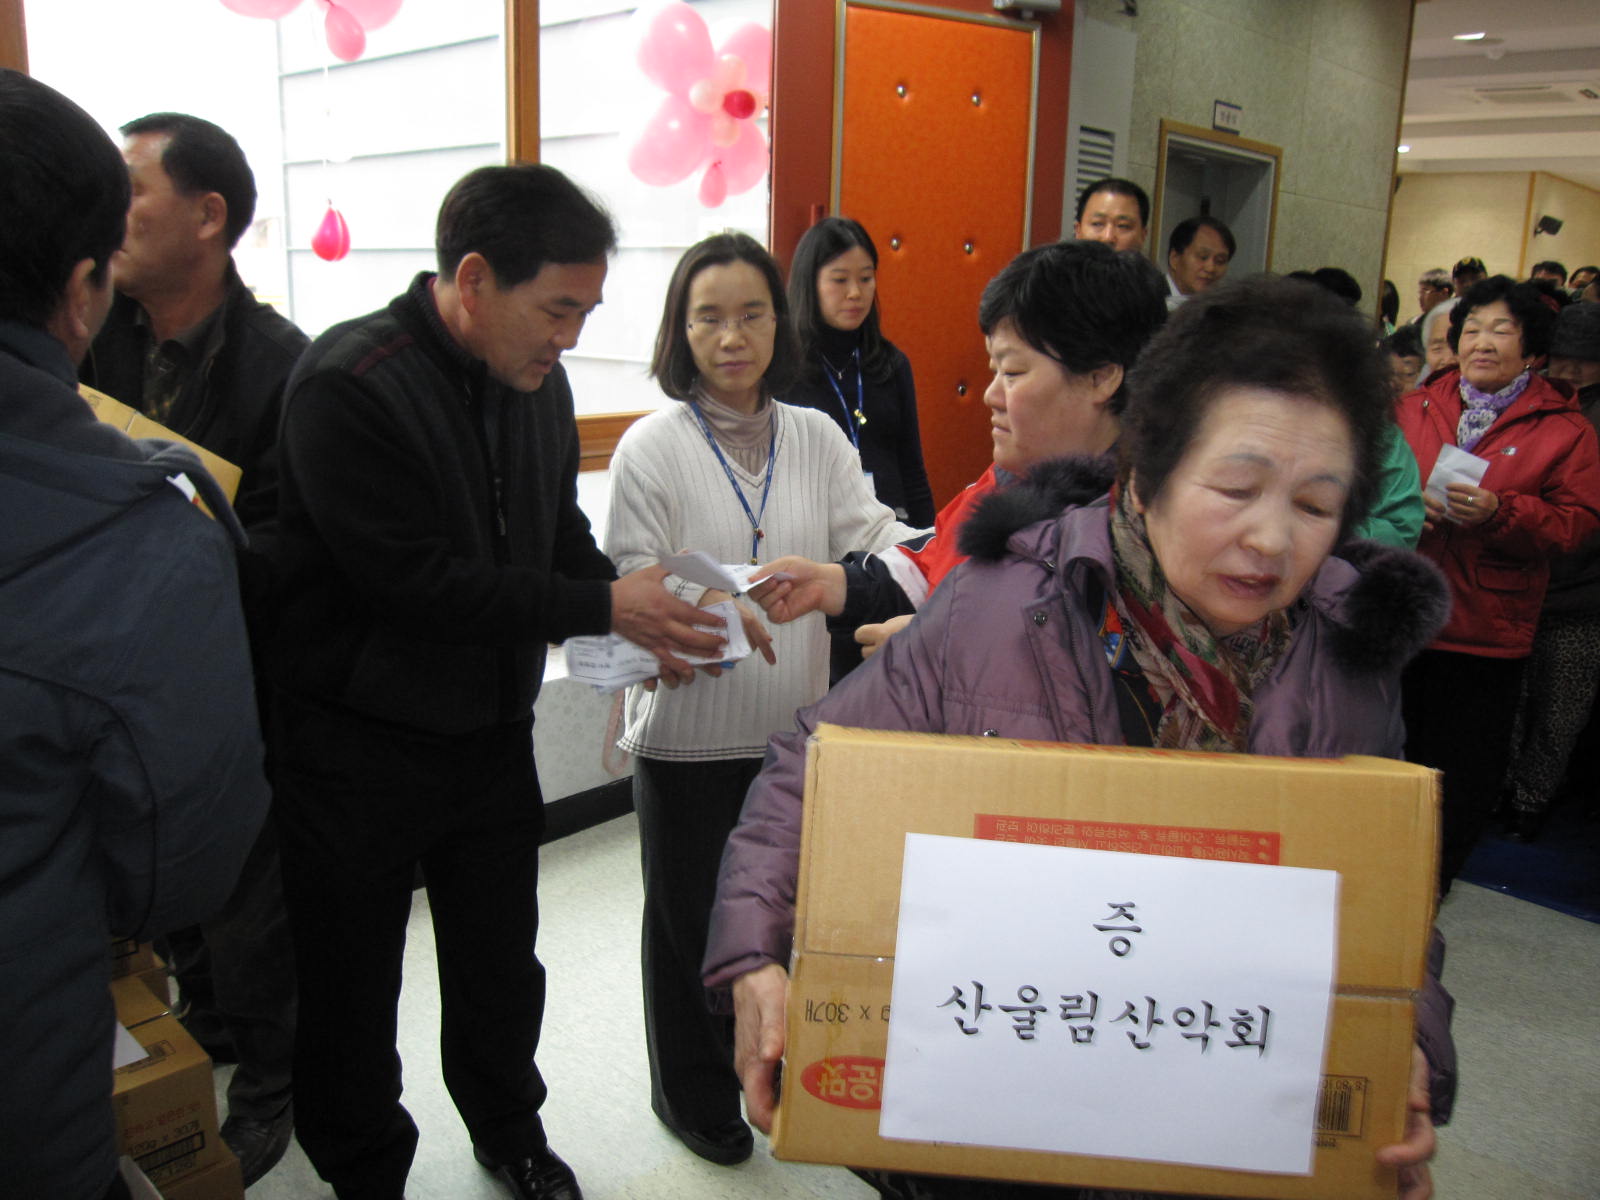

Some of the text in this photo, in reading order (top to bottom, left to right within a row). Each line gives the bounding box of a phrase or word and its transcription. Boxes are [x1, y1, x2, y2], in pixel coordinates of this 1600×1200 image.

[1092, 900, 1143, 957] 증
[804, 999, 851, 1024] 30개
[936, 980, 1274, 1058] 산울림산악회
[817, 1062, 886, 1102] 운맛
